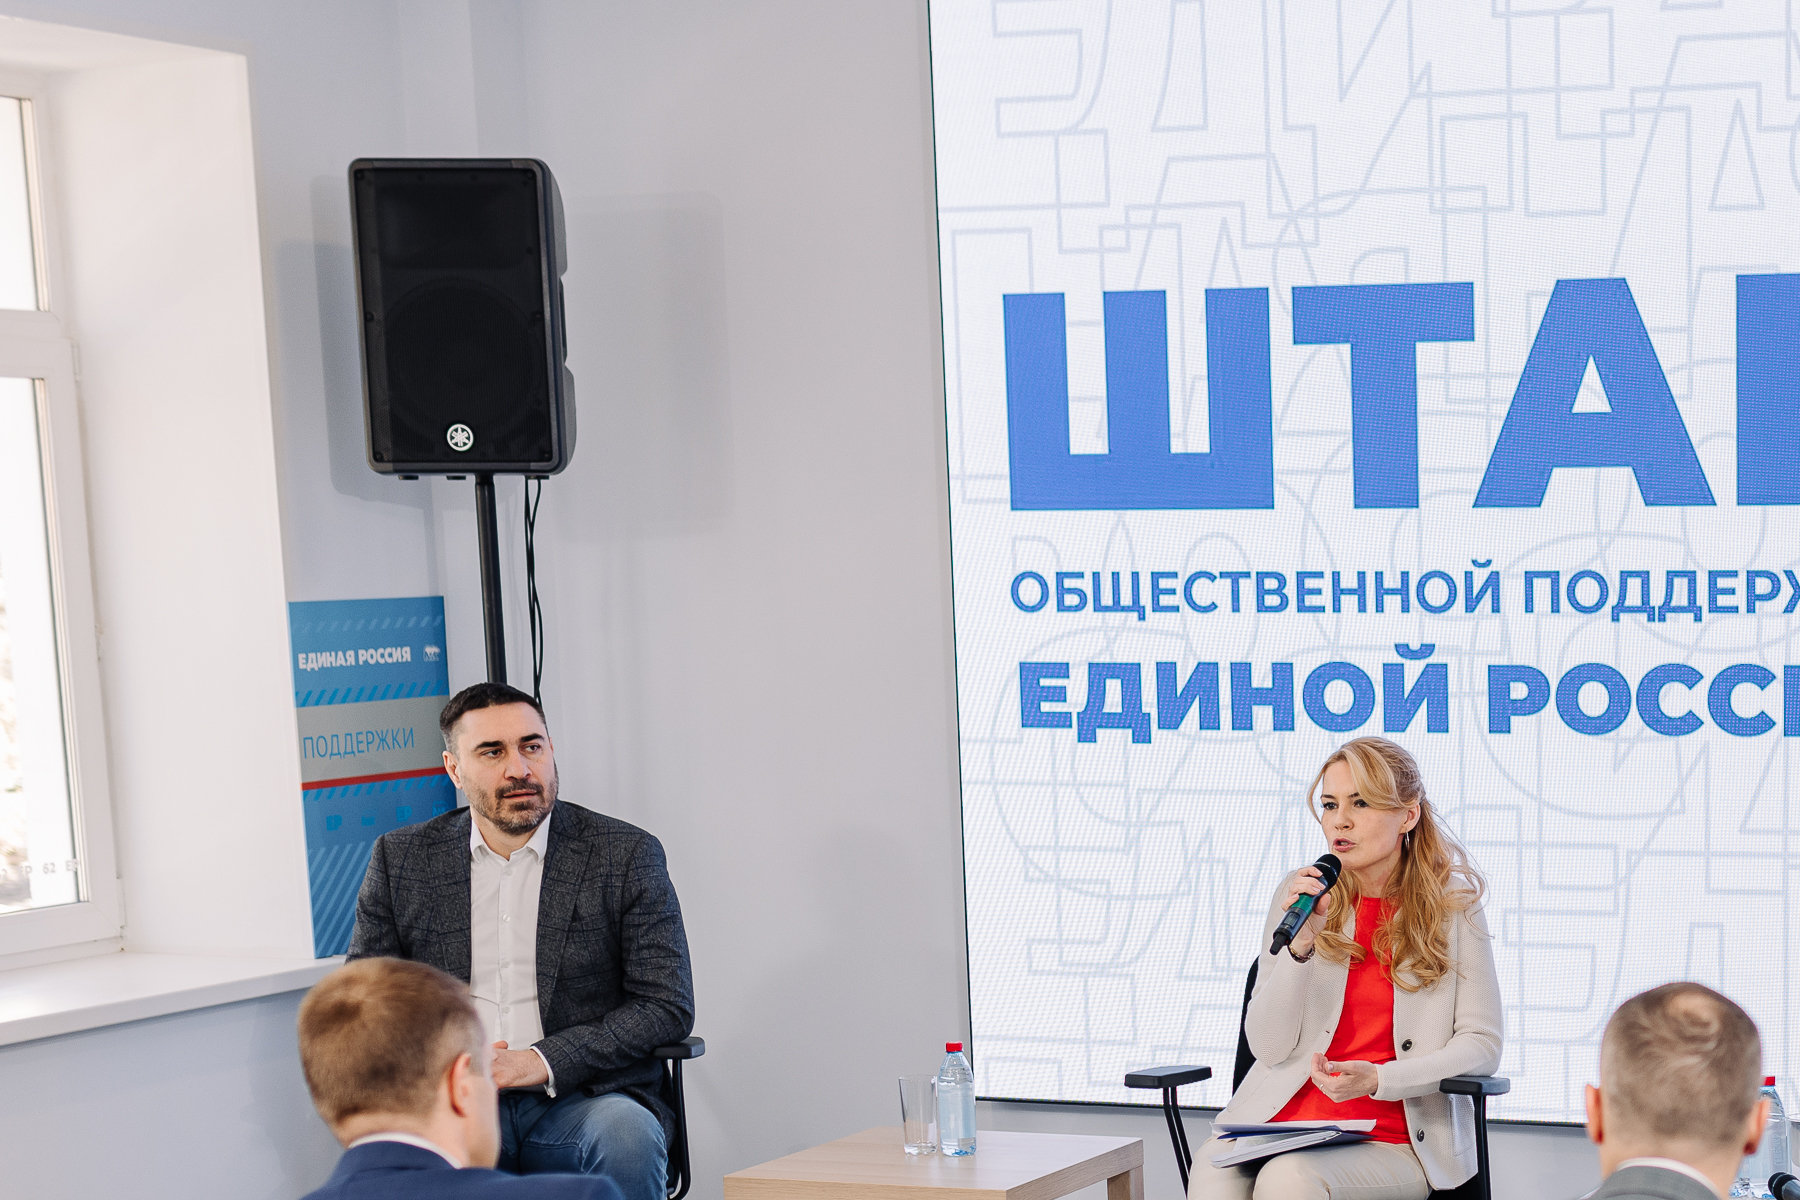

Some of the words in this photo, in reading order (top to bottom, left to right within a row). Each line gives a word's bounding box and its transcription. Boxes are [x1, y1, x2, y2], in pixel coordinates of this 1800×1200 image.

[1009, 558, 1502, 623] ОБЩЕСТВЕННОЙ
[298, 650, 355, 672] ЕДИНАЯ
[358, 646, 411, 665] РОССИЯ
[1017, 642, 1451, 745] ЕДИНОЙ
[303, 727, 415, 760] ПОДДЕРЖКИ
